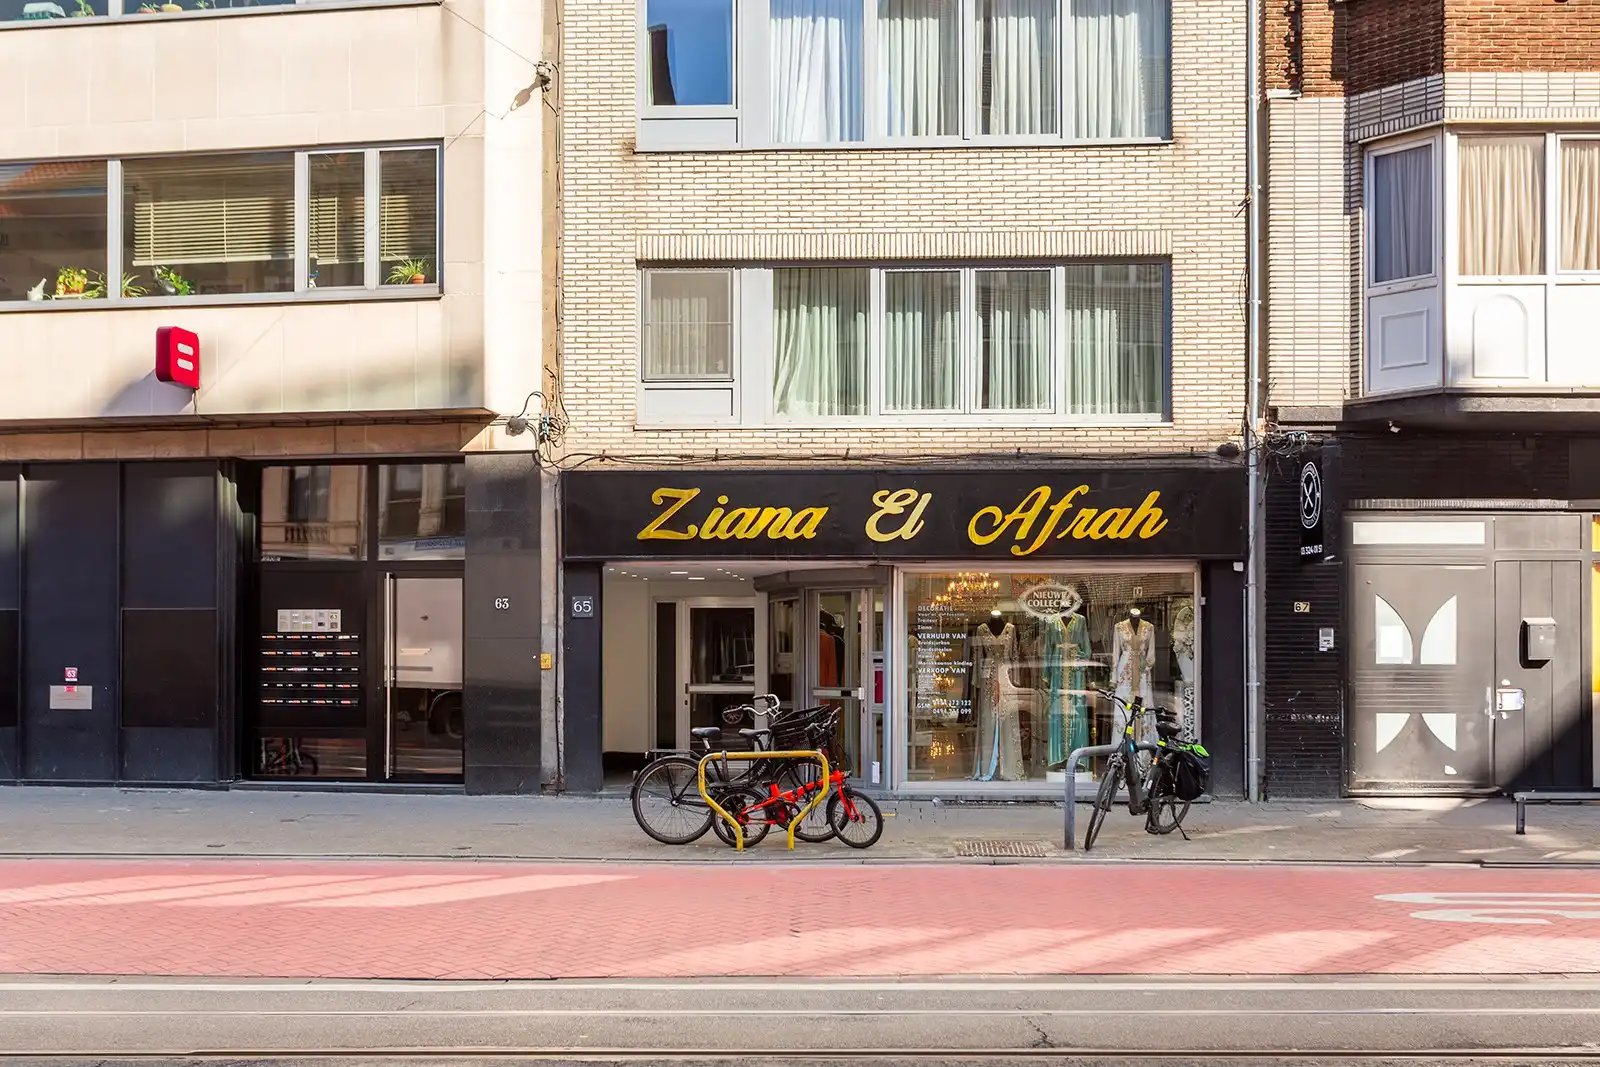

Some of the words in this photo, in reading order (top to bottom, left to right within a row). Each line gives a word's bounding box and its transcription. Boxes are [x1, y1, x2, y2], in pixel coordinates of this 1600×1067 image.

[637, 487, 829, 540] Ziana
[865, 488, 932, 542] El
[967, 484, 1168, 556] Afrah
[495, 598, 509, 610] 63
[573, 600, 592, 612] 65
[1296, 602, 1308, 612] 67
